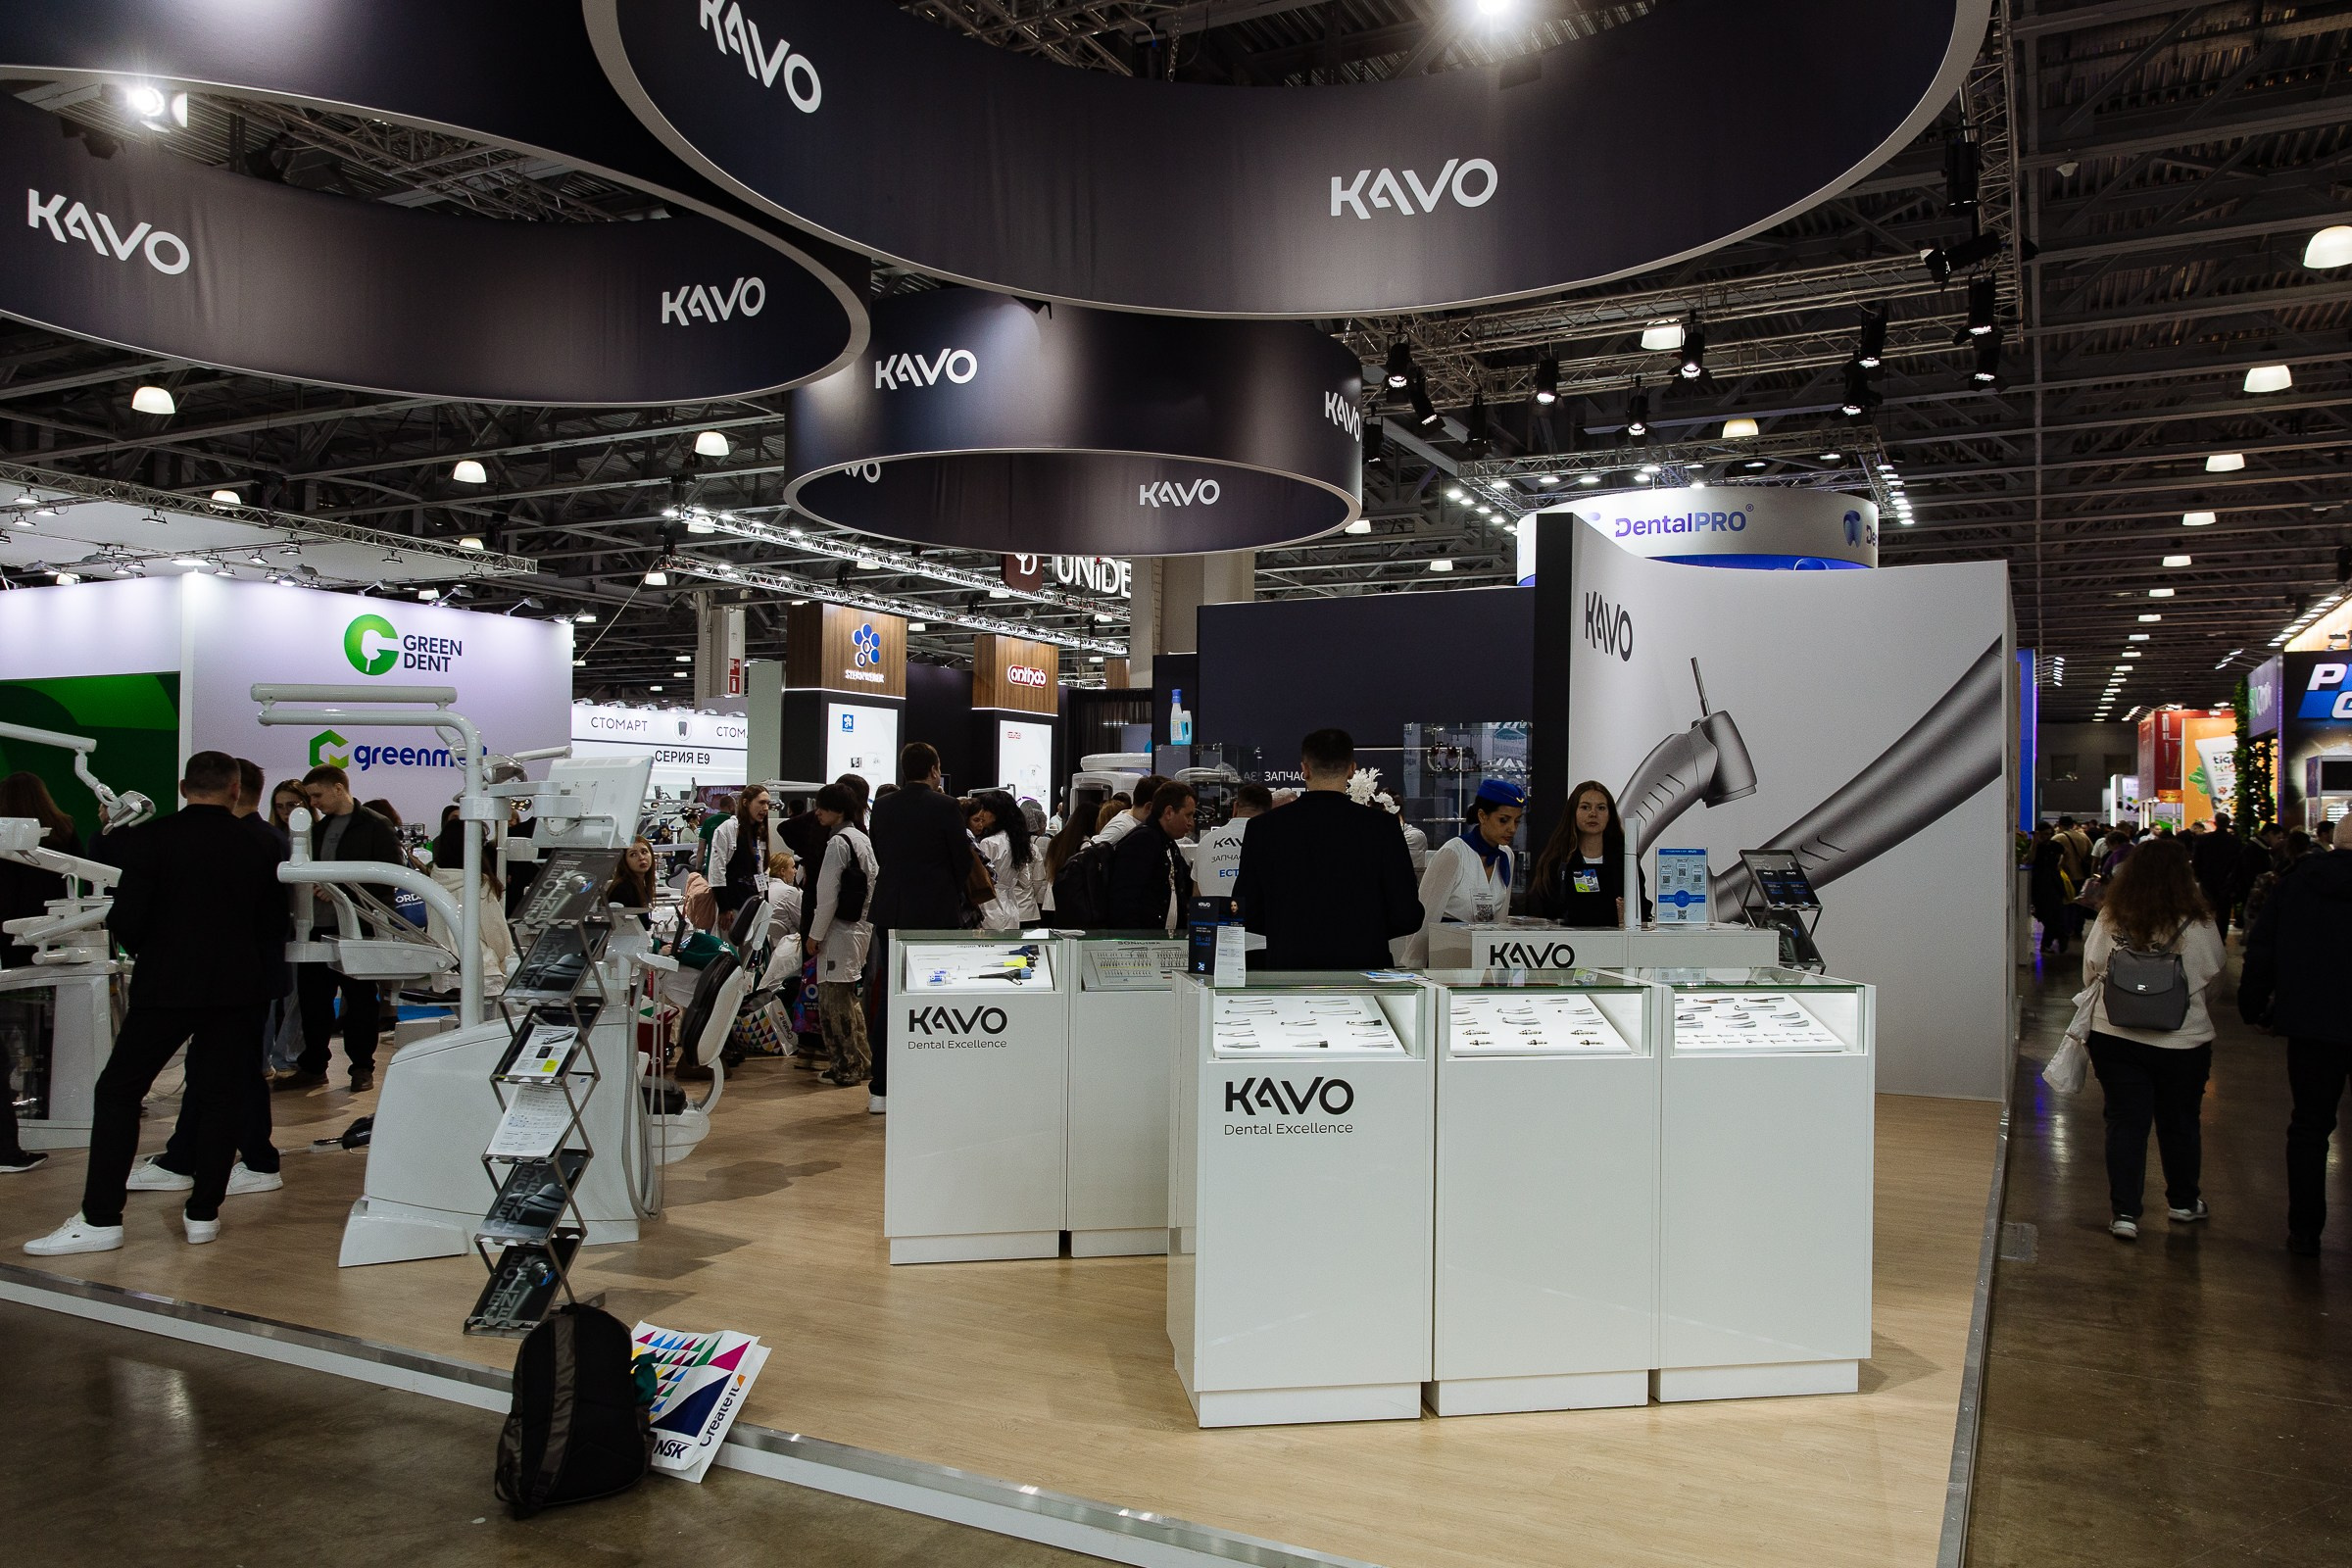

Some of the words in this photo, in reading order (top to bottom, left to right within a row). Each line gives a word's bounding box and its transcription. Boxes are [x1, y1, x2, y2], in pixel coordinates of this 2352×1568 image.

[700, 0, 822, 114] KAVO
[1330, 158, 1498, 220] KAVO
[27, 188, 190, 275] KAVO
[662, 276, 766, 326] KAVO
[875, 348, 978, 390] KAVO
[1324, 390, 1360, 443] KAVO
[1139, 478, 1220, 508] KAVO
[1585, 590, 1634, 662] KAVO
[403, 634, 463, 657] GREEN
[404, 652, 452, 673] DENT
[590, 716, 648, 732] СТОМАРТ
[715, 726, 748, 739] СТОМ
[655, 750, 694, 763] СЕРИЯ
[1211, 854, 1241, 863] ЗАПЧА
[1490, 942, 1576, 969] KAVO
[908, 1004, 1008, 1036] KAVO
[907, 1040, 946, 1050] Dental
[948, 1039, 1007, 1049] Excellence
[1225, 1076, 1354, 1116] KAVO
[1224, 1123, 1273, 1136] Dental
[1276, 1122, 1353, 1135] Excellence
[654, 1439, 693, 1459] NSK
